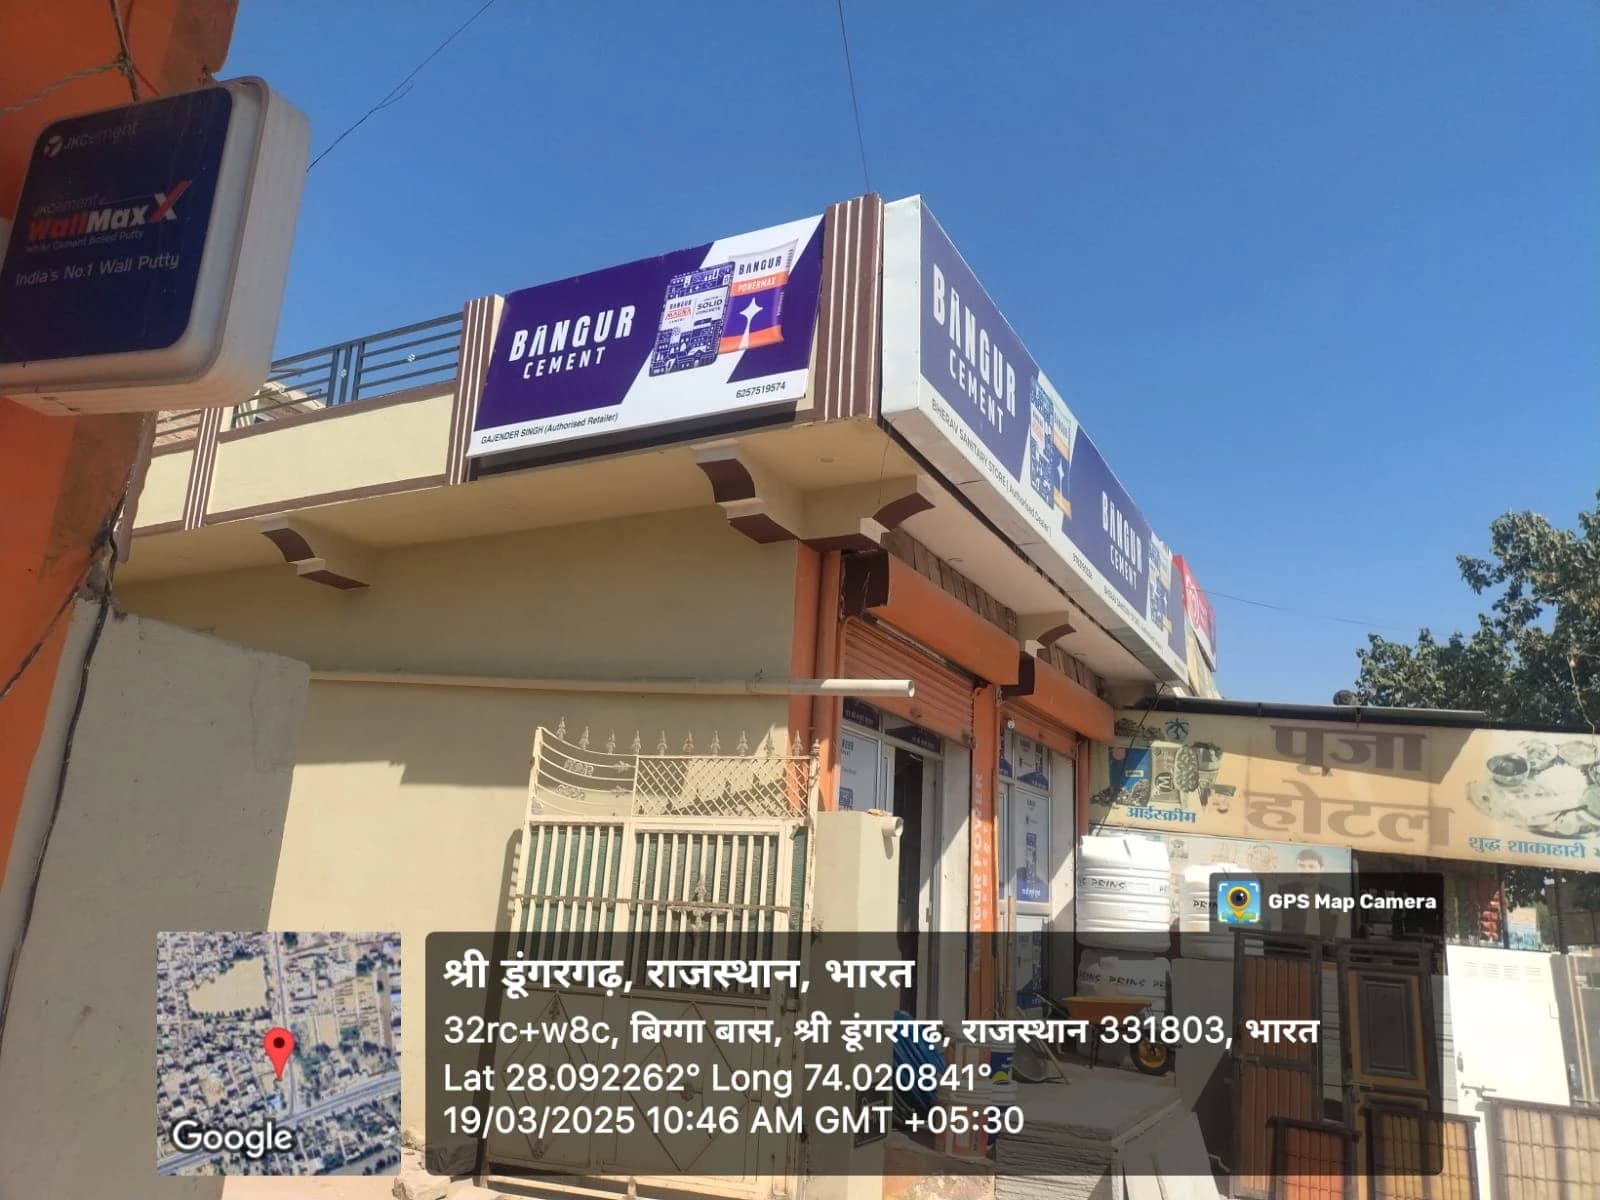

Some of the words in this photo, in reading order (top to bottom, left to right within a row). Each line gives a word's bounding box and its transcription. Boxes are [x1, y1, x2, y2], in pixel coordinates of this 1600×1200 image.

[119, 229, 144, 241] Putty
[16, 269, 59, 286] India's
[63, 264, 93, 280] No.1
[100, 259, 132, 275] Wall
[138, 252, 180, 270] Putty
[738, 255, 782, 275] BANGUR
[696, 298, 723, 310] SOLID
[508, 304, 636, 362] BANGUR
[933, 263, 1016, 418] BANGUR
[523, 346, 606, 379] CEMENT
[735, 381, 786, 399] 6257519574
[949, 348, 1004, 434] CEMENT
[480, 429, 520, 445] GAJENDER
[520, 425, 544, 439] SINGH
[544, 415, 587, 435] (Authorised
[587, 412, 619, 426] Retailer)
[987, 460, 1006, 487] STORE
[1101, 490, 1142, 576] BANGUR
[1110, 544, 1137, 591] CEMENT
[1269, 724, 1427, 777] पूजा
[1244, 780, 1455, 847] होटल
[1469, 836, 1501, 853] शुद्ध
[1508, 839, 1586, 859] शाकाहारी
